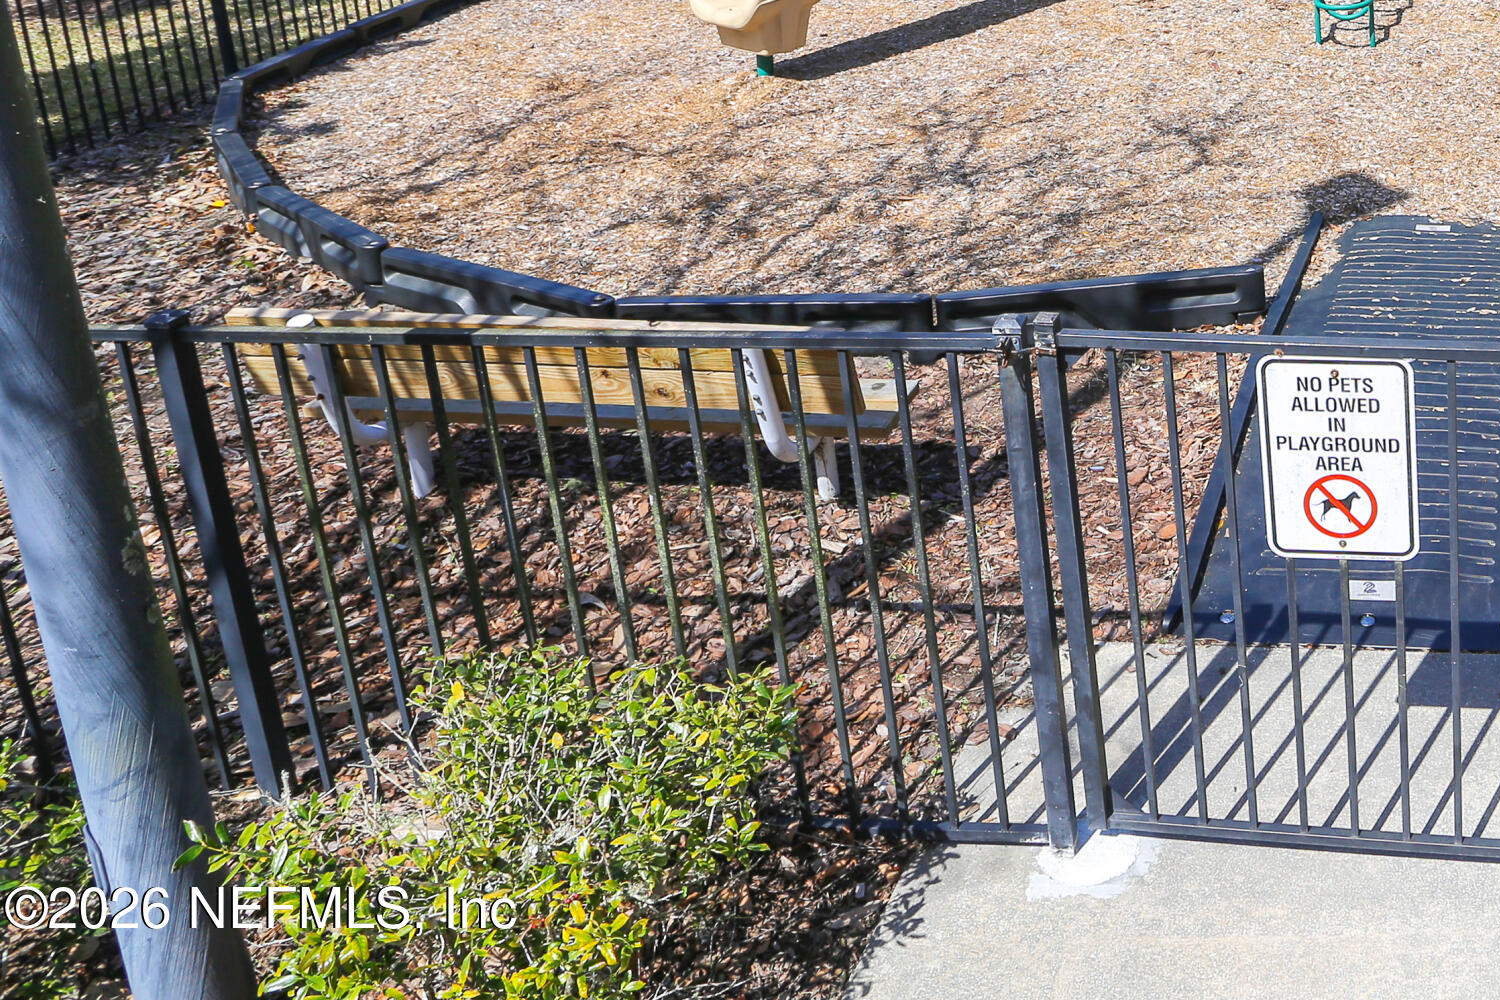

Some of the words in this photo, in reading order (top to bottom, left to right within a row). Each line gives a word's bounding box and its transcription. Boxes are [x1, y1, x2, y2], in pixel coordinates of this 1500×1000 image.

[1297, 376, 1322, 392] NO
[1328, 377, 1373, 393] PETS
[1291, 397, 1380, 413] ALLOWED
[1327, 417, 1346, 432] IN
[1276, 436, 1400, 453] PLAYGROUND
[1315, 457, 1363, 471] AREA
